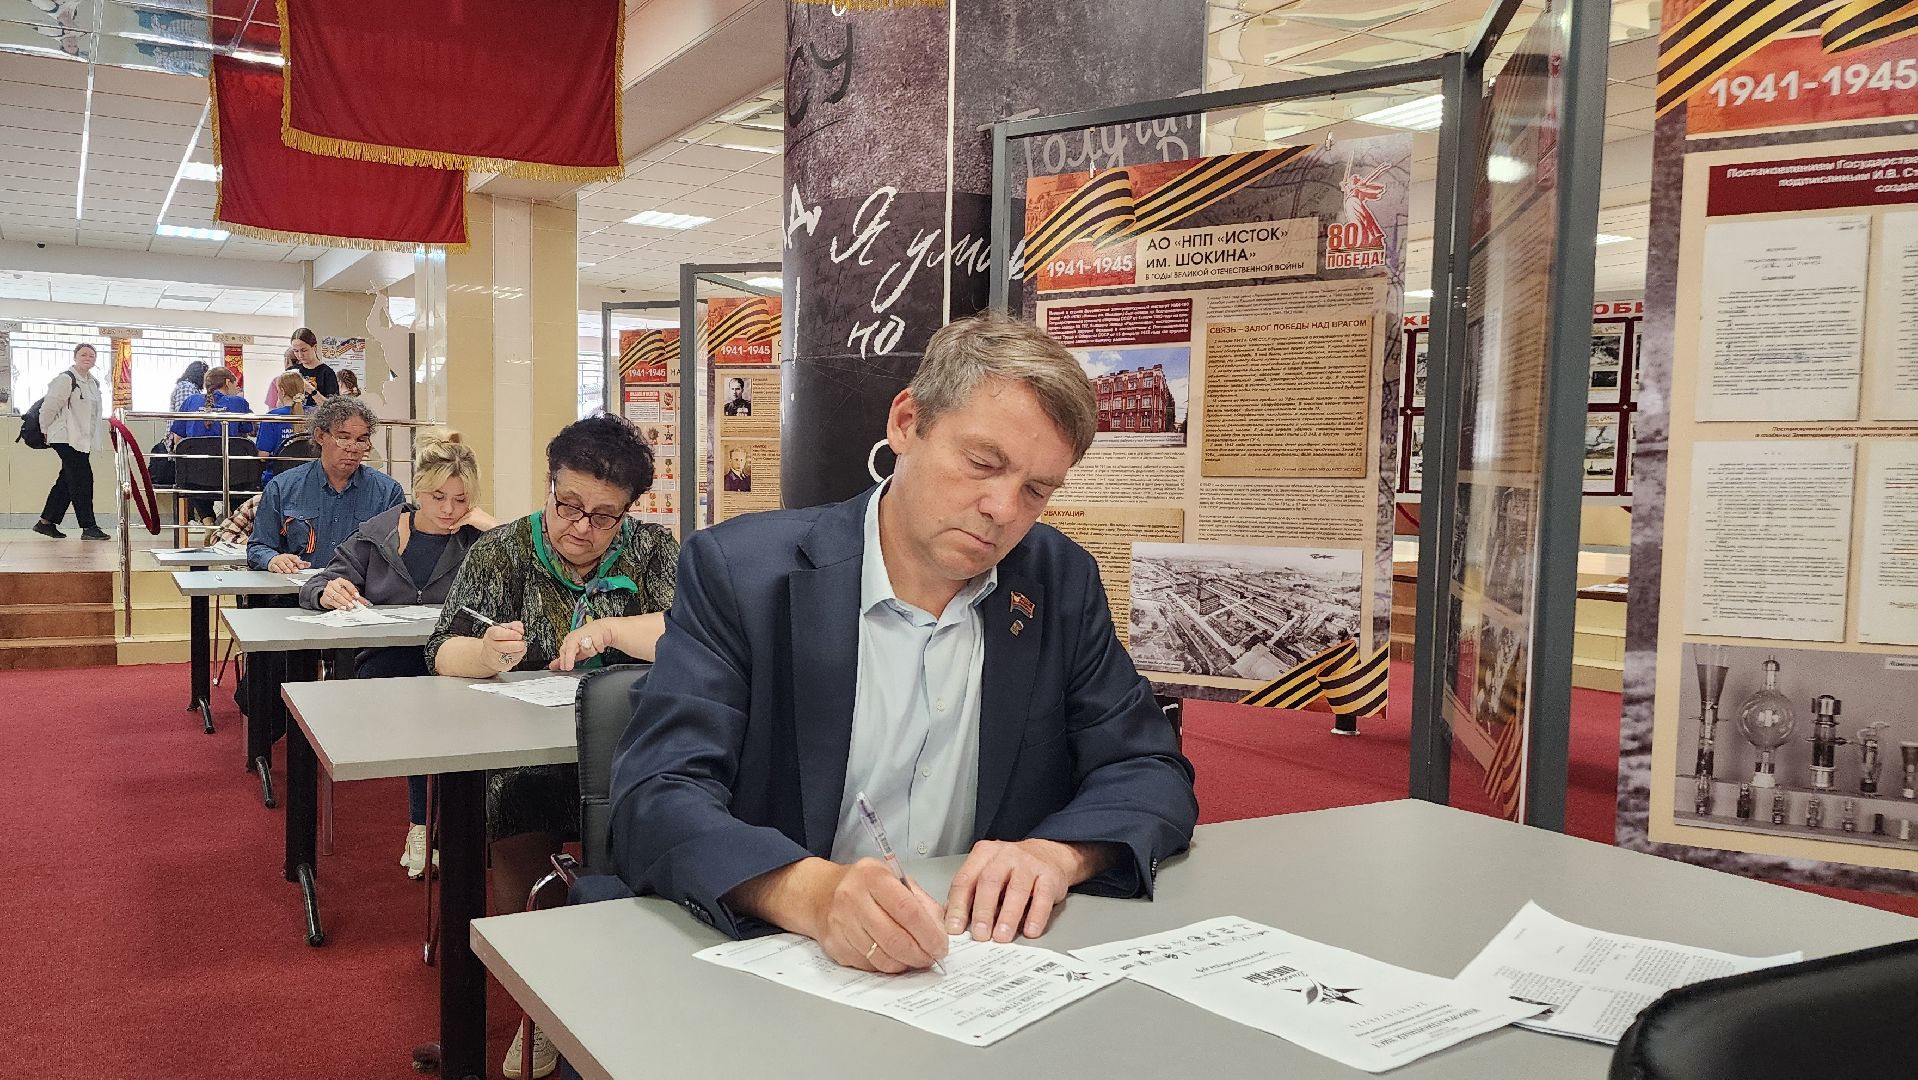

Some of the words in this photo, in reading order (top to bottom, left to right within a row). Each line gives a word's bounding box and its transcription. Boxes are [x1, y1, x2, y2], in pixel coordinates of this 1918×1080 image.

[1708, 58, 1918, 108] 1941-1945
[830, 186, 898, 265] Я
[1146, 237, 1171, 251] АО
[1174, 234, 1213, 248] «НПП
[1217, 227, 1289, 245] «ИСТОК»
[1328, 222, 1359, 251] 80
[1046, 254, 1134, 278] 1941-1945
[1146, 257, 1171, 269] ИМ.
[1175, 249, 1256, 267] ШОКИНА»
[1327, 251, 1385, 268] ПОБЕДА!
[1173, 269, 1209, 279] ВЕЛИКОЙ
[1210, 264, 1274, 276] ОТЕЧЕСТВЕННОЙ
[1274, 261, 1305, 271] ВОЙНЫ
[1209, 326, 1237, 334] СВЯЗЬ
[1244, 324, 1272, 333] ЗАЛОГ
[1273, 323, 1310, 331] ПОБЕДЫ
[1311, 322, 1330, 330] НАД
[1331, 319, 1367, 328] ВРАГОМ
[846, 315, 906, 360] но
[720, 345, 771, 356] 1941-1945
[629, 368, 666, 377] 1941-1945
[1043, 510, 1085, 518] ЭВАКУАЦИЯ
